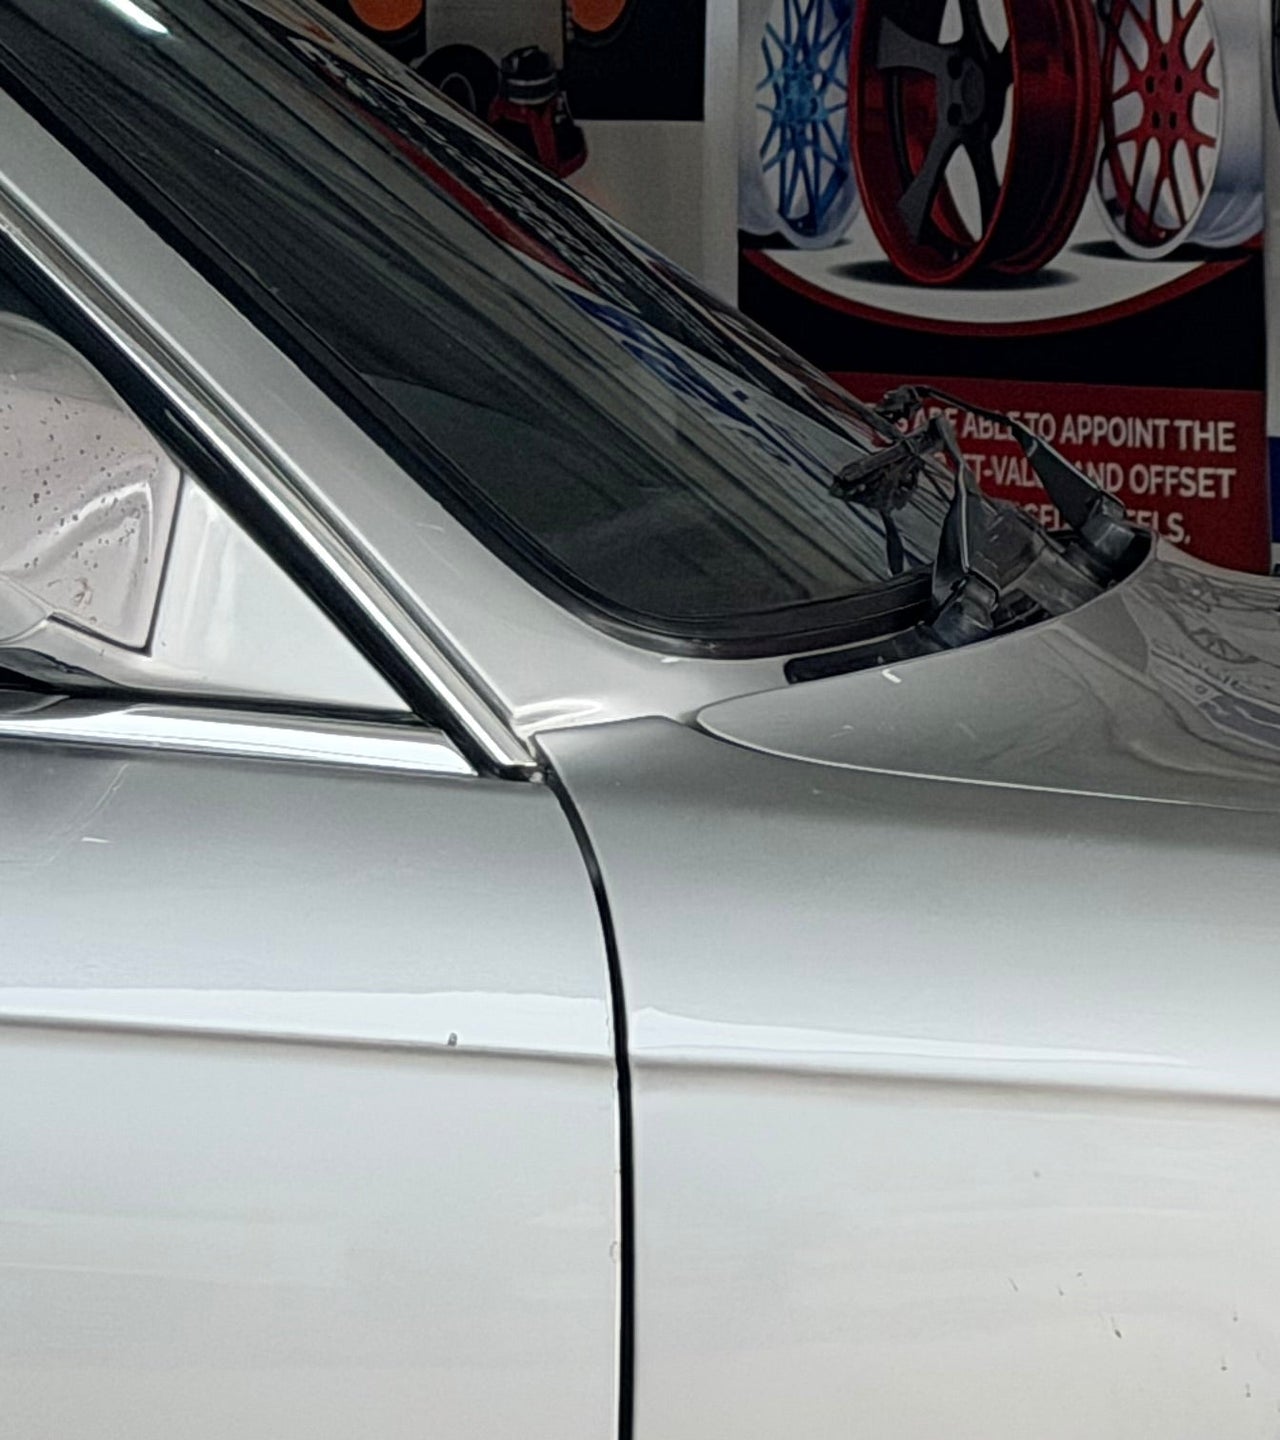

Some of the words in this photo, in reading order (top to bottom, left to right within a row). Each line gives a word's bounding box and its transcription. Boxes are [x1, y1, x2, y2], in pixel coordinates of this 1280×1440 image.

[1023, 411, 1057, 443] TO
[1060, 415, 1174, 450] APPOINT
[1174, 420, 1237, 453] THE
[1075, 460, 1125, 494] ND
[1129, 463, 1237, 499] OFFSET
